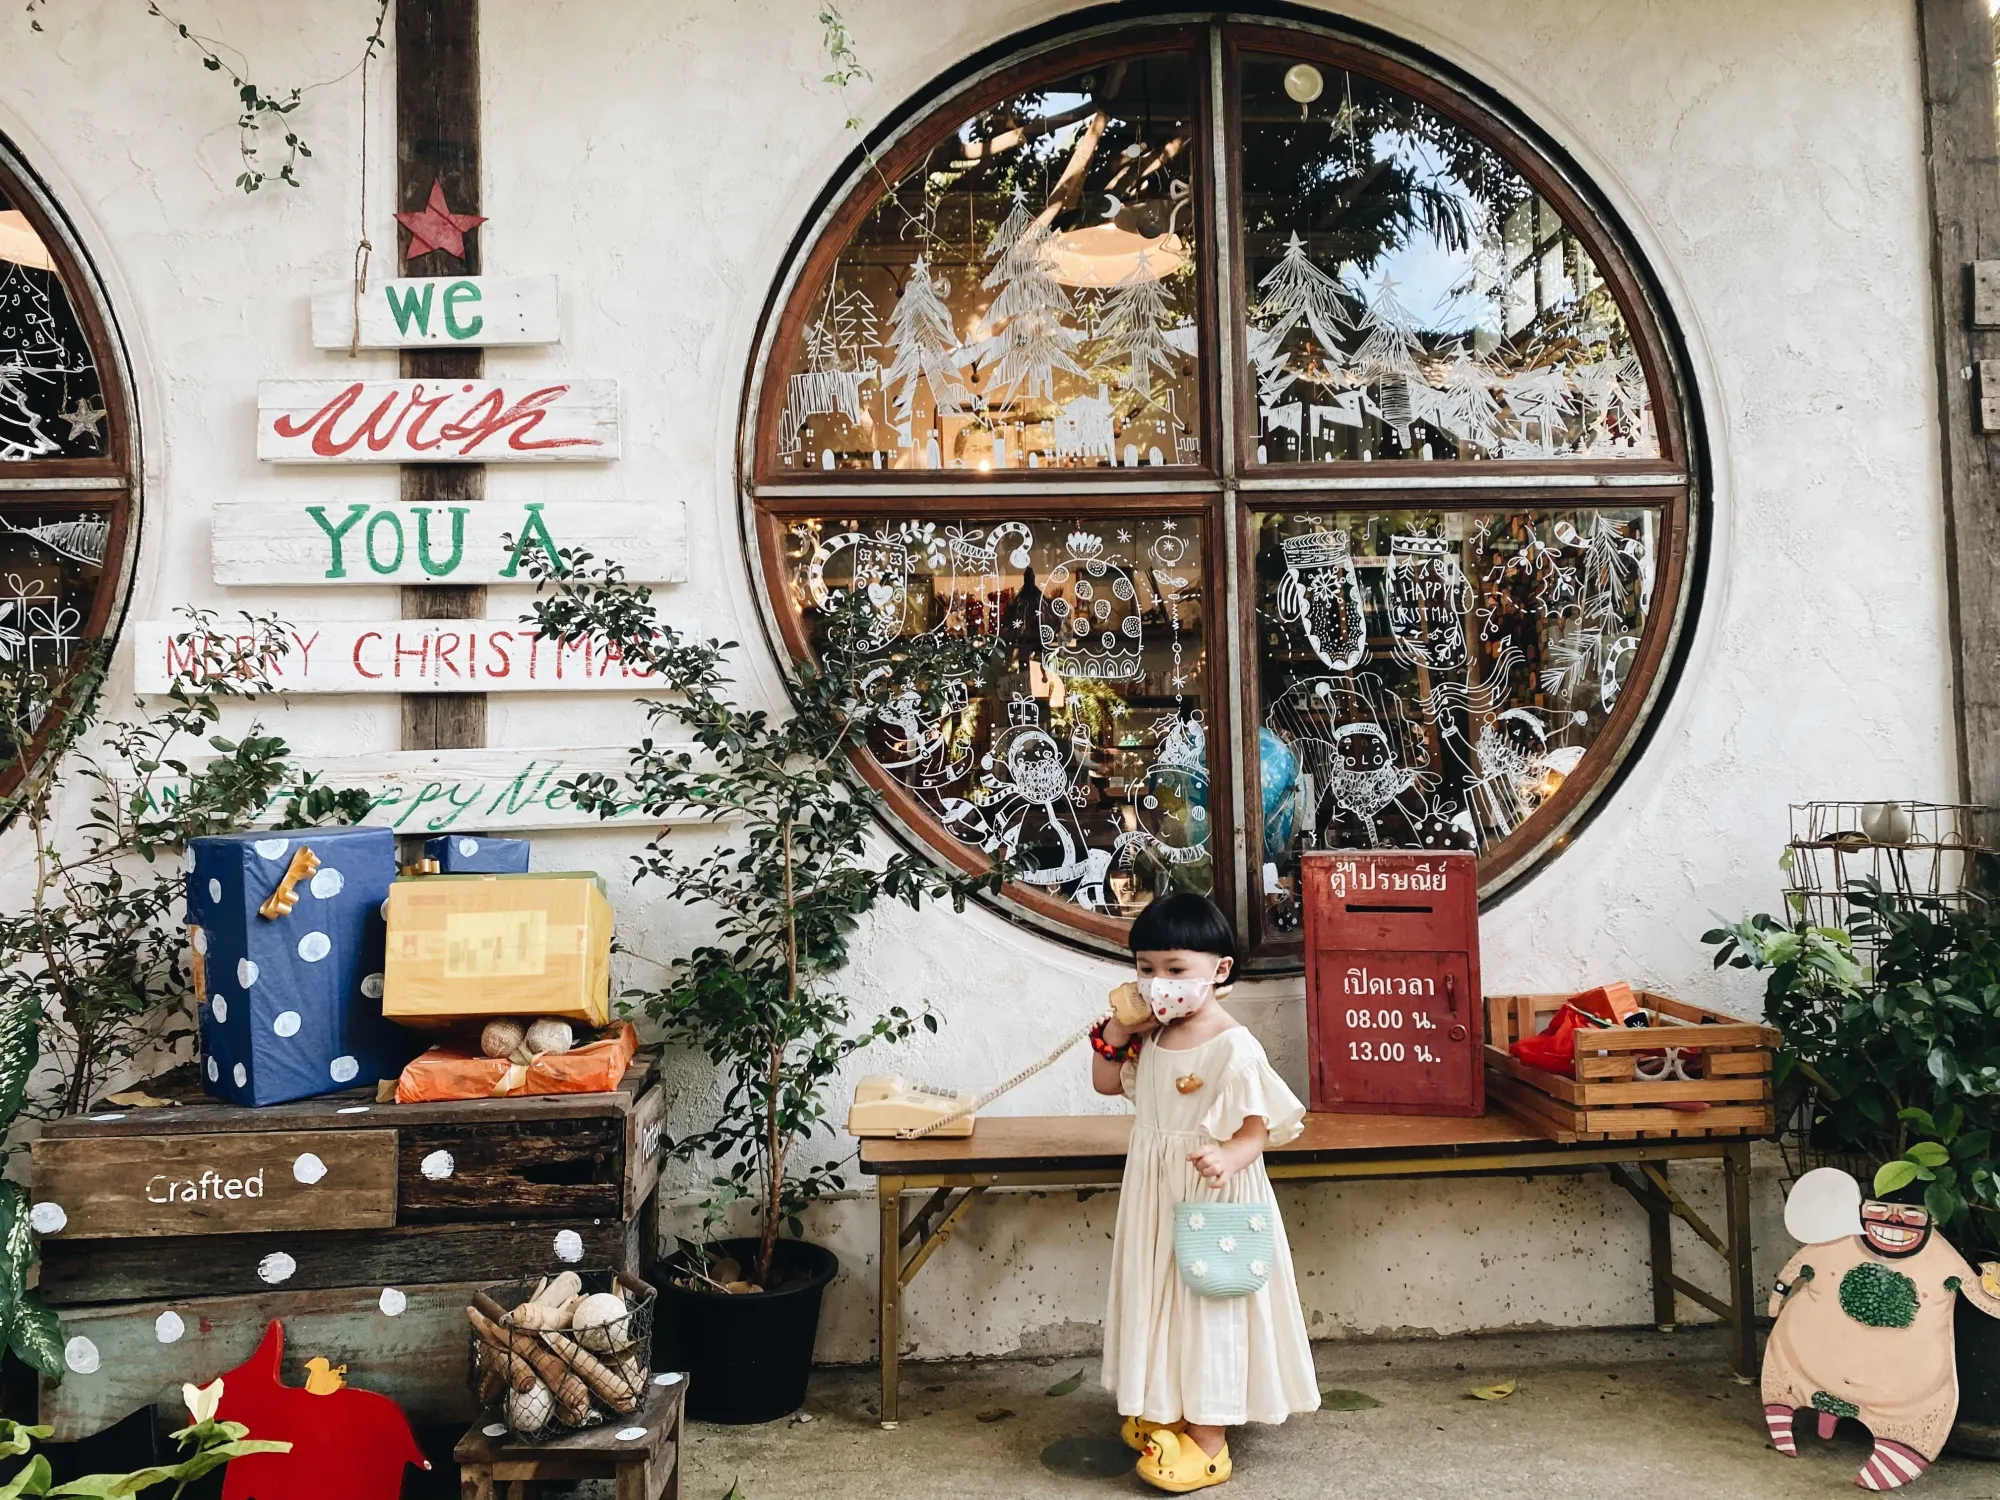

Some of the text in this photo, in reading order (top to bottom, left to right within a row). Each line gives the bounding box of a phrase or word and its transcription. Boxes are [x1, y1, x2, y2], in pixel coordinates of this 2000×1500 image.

[305, 502, 571, 579] YOU A
[1402, 581, 1451, 601] HAPPY
[166, 629, 662, 681] MERRY CHRISTMAS
[1330, 860, 1448, 898] ตู้ไปรษณีย์
[1344, 967, 1435, 996] เปิดเวลา
[1345, 1009, 1437, 1029] 08.00 น.
[1348, 1041, 1441, 1063] 13.00 น.
[145, 1167, 264, 1204] Crafted
